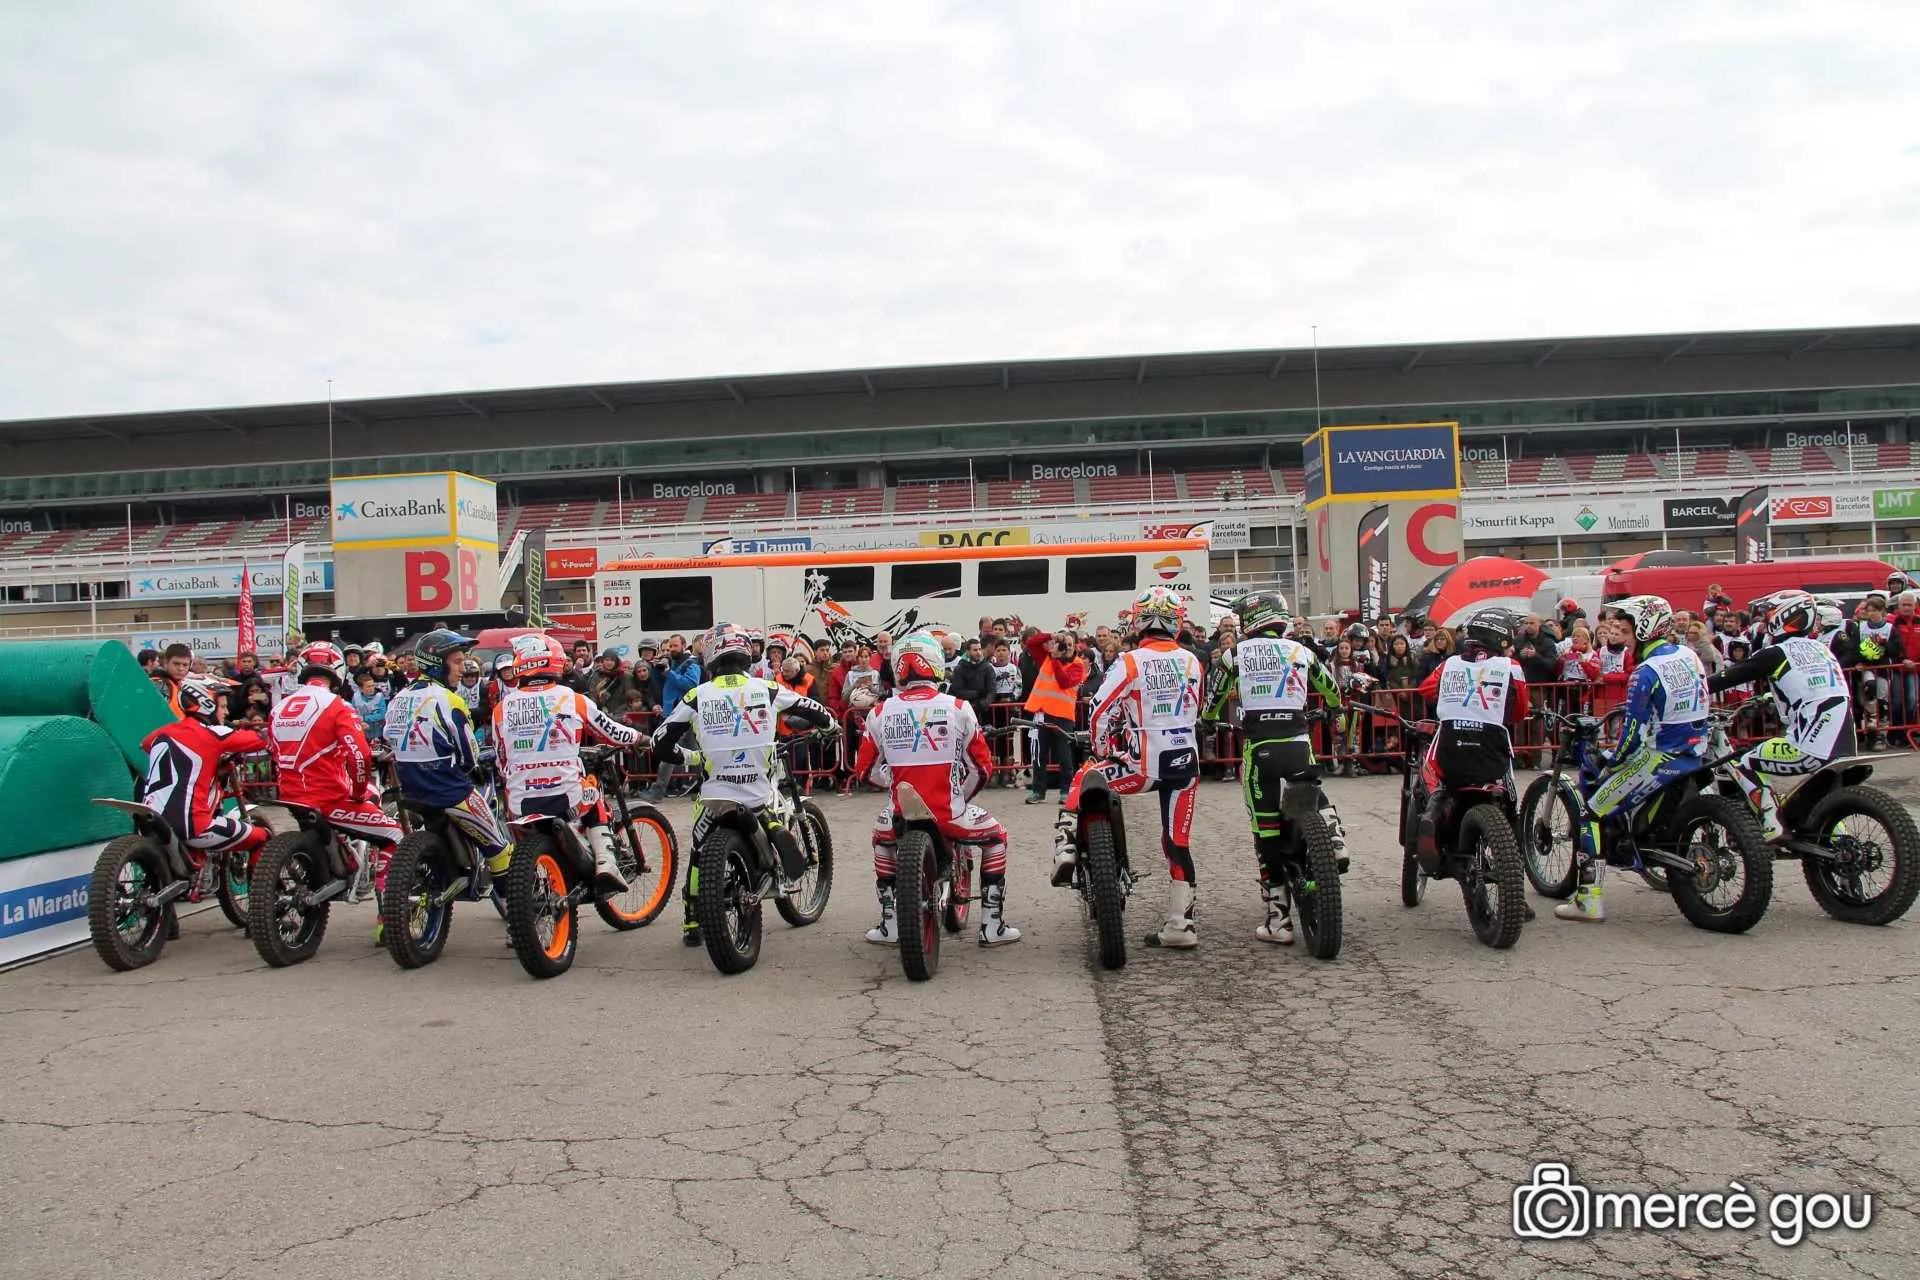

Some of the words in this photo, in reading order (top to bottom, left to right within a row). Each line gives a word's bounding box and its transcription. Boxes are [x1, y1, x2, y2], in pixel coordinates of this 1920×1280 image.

[1786, 431, 1868, 448] Barcelona
[1338, 452, 1357, 464] LA
[1357, 448, 1445, 462] VANGUARDIA
[1032, 464, 1117, 480] Barcelona
[653, 481, 735, 499] Barcelona
[361, 498, 446, 518] CaixaBank
[1836, 503, 1870, 511] Barcelona
[1878, 492, 1915, 508] JMT
[1, 518, 32, 533] lona
[1475, 516, 1517, 528] Smurfit
[1520, 514, 1554, 528] Kappa
[1608, 514, 1649, 529] Montmeló
[1406, 503, 1458, 566] C
[756, 540, 806, 552] Damm
[157, 576, 220, 592] CaixaBank
[405, 550, 453, 612] B
[459, 550, 478, 611] B
[603, 596, 631, 607] DID
[915, 655, 930, 670] TNT
[276, 720, 306, 729] GASGAS
[1759, 758, 1822, 775] MOTS
[1596, 751, 1651, 802] SHERCO
[329, 808, 397, 826] GASGAS
[3, 903, 24, 926] La
[28, 885, 88, 920] Marató
